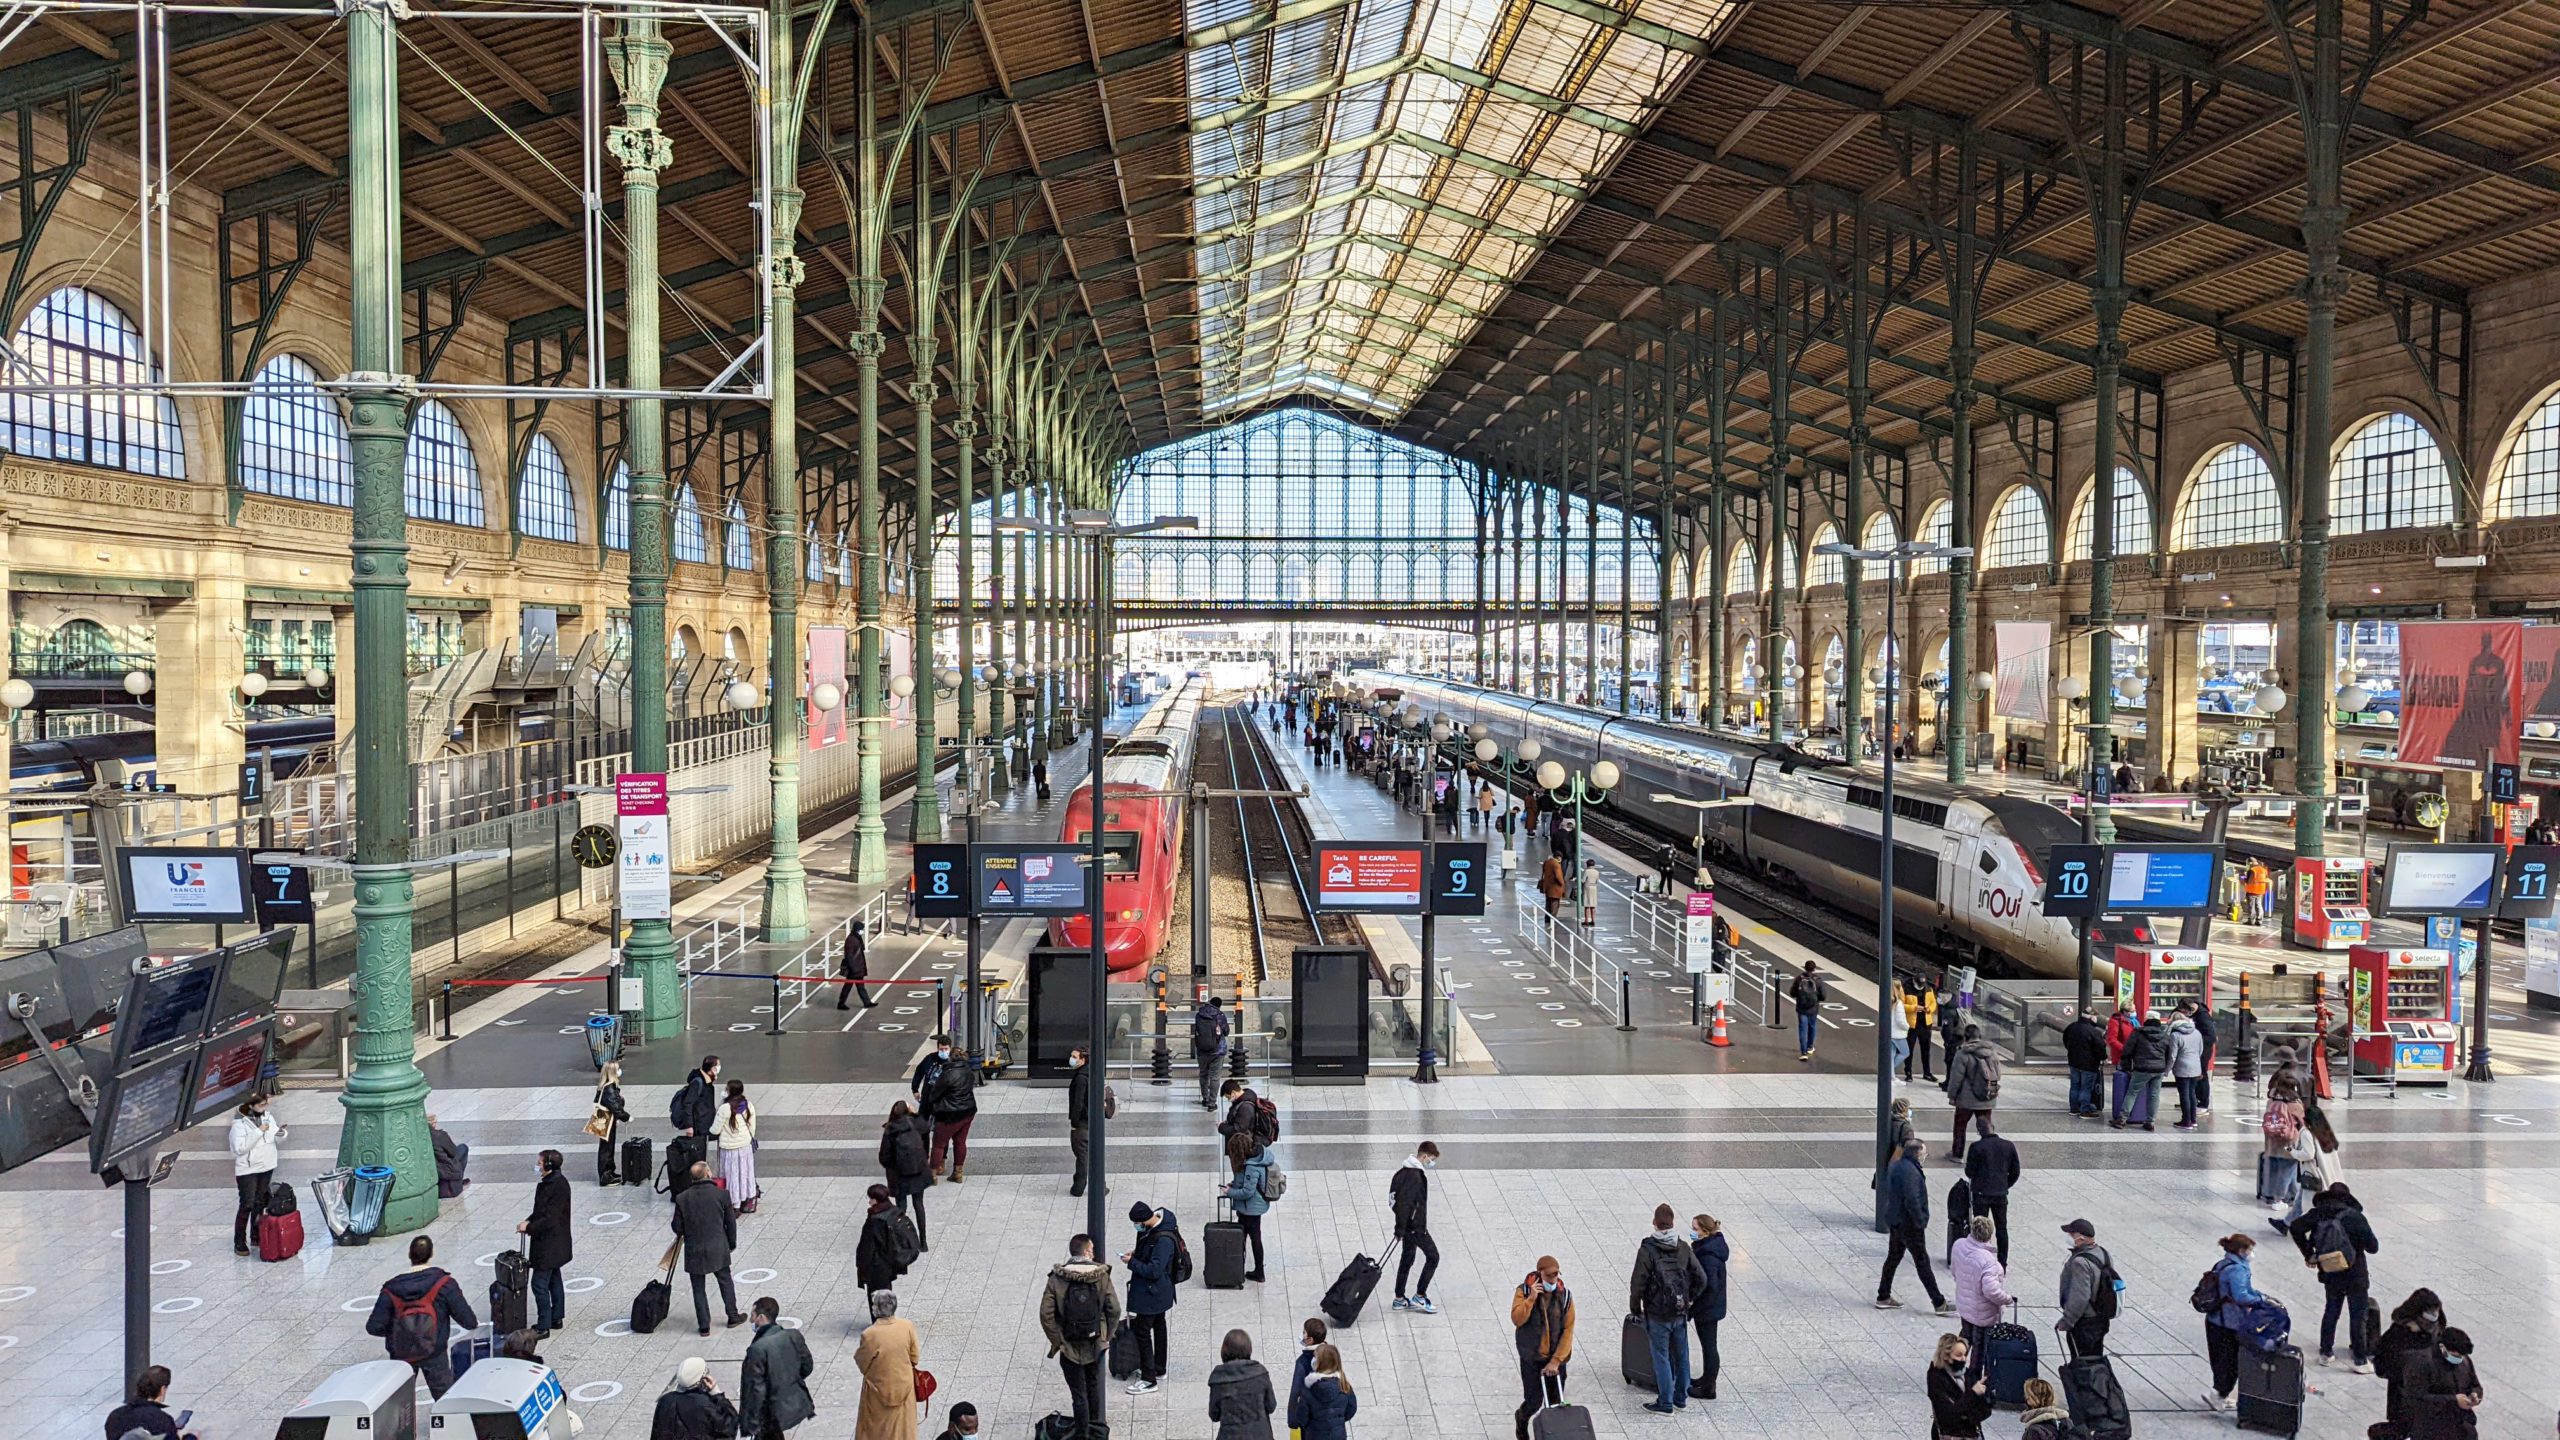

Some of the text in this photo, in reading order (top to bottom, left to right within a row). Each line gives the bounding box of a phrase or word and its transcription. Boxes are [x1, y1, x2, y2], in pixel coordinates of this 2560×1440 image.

[2275, 749, 2282, 758] R
[247, 777, 255, 795] 7
[2096, 776, 2106, 794] 10
[2498, 777, 2514, 796] 11
[272, 878, 290, 899] 7
[933, 872, 949, 894] 8
[1452, 871, 1467, 893] 9
[1981, 877, 1992, 888] TGV
[2058, 872, 2089, 894] 10
[2518, 874, 2548, 895] 11
